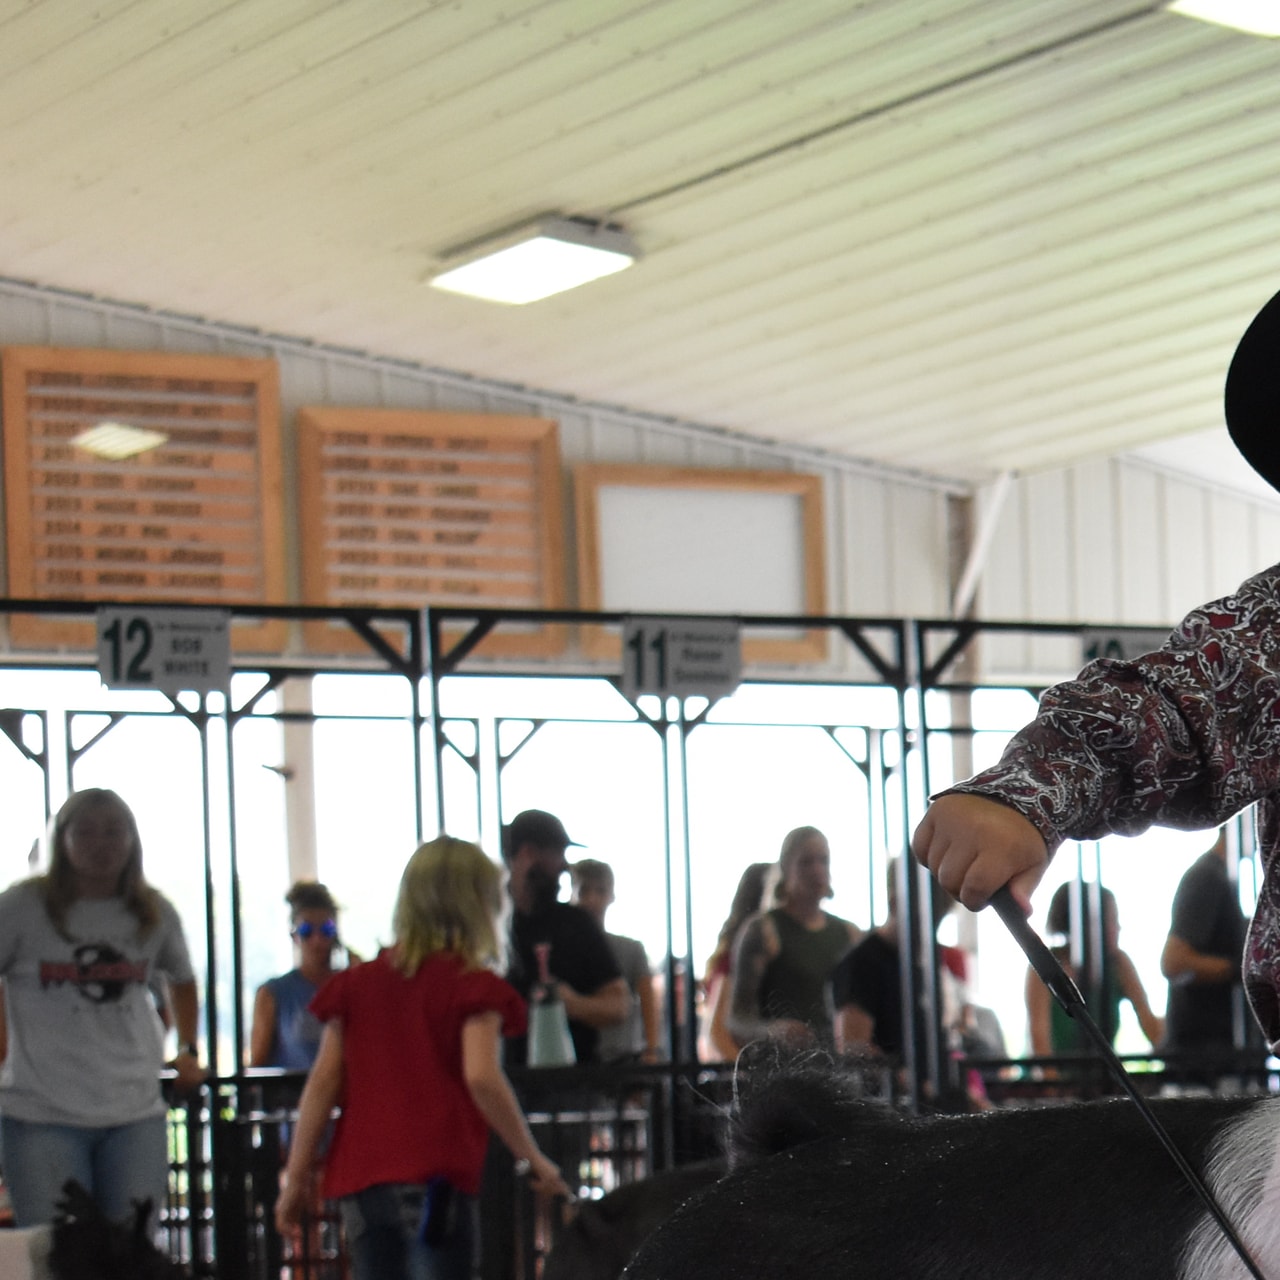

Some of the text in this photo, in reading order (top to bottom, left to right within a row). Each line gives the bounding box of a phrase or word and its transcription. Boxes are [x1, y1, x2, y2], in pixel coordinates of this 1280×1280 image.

[103, 616, 153, 682] 12
[164, 659, 209, 675] WHITE
[628, 628, 667, 690] 11
